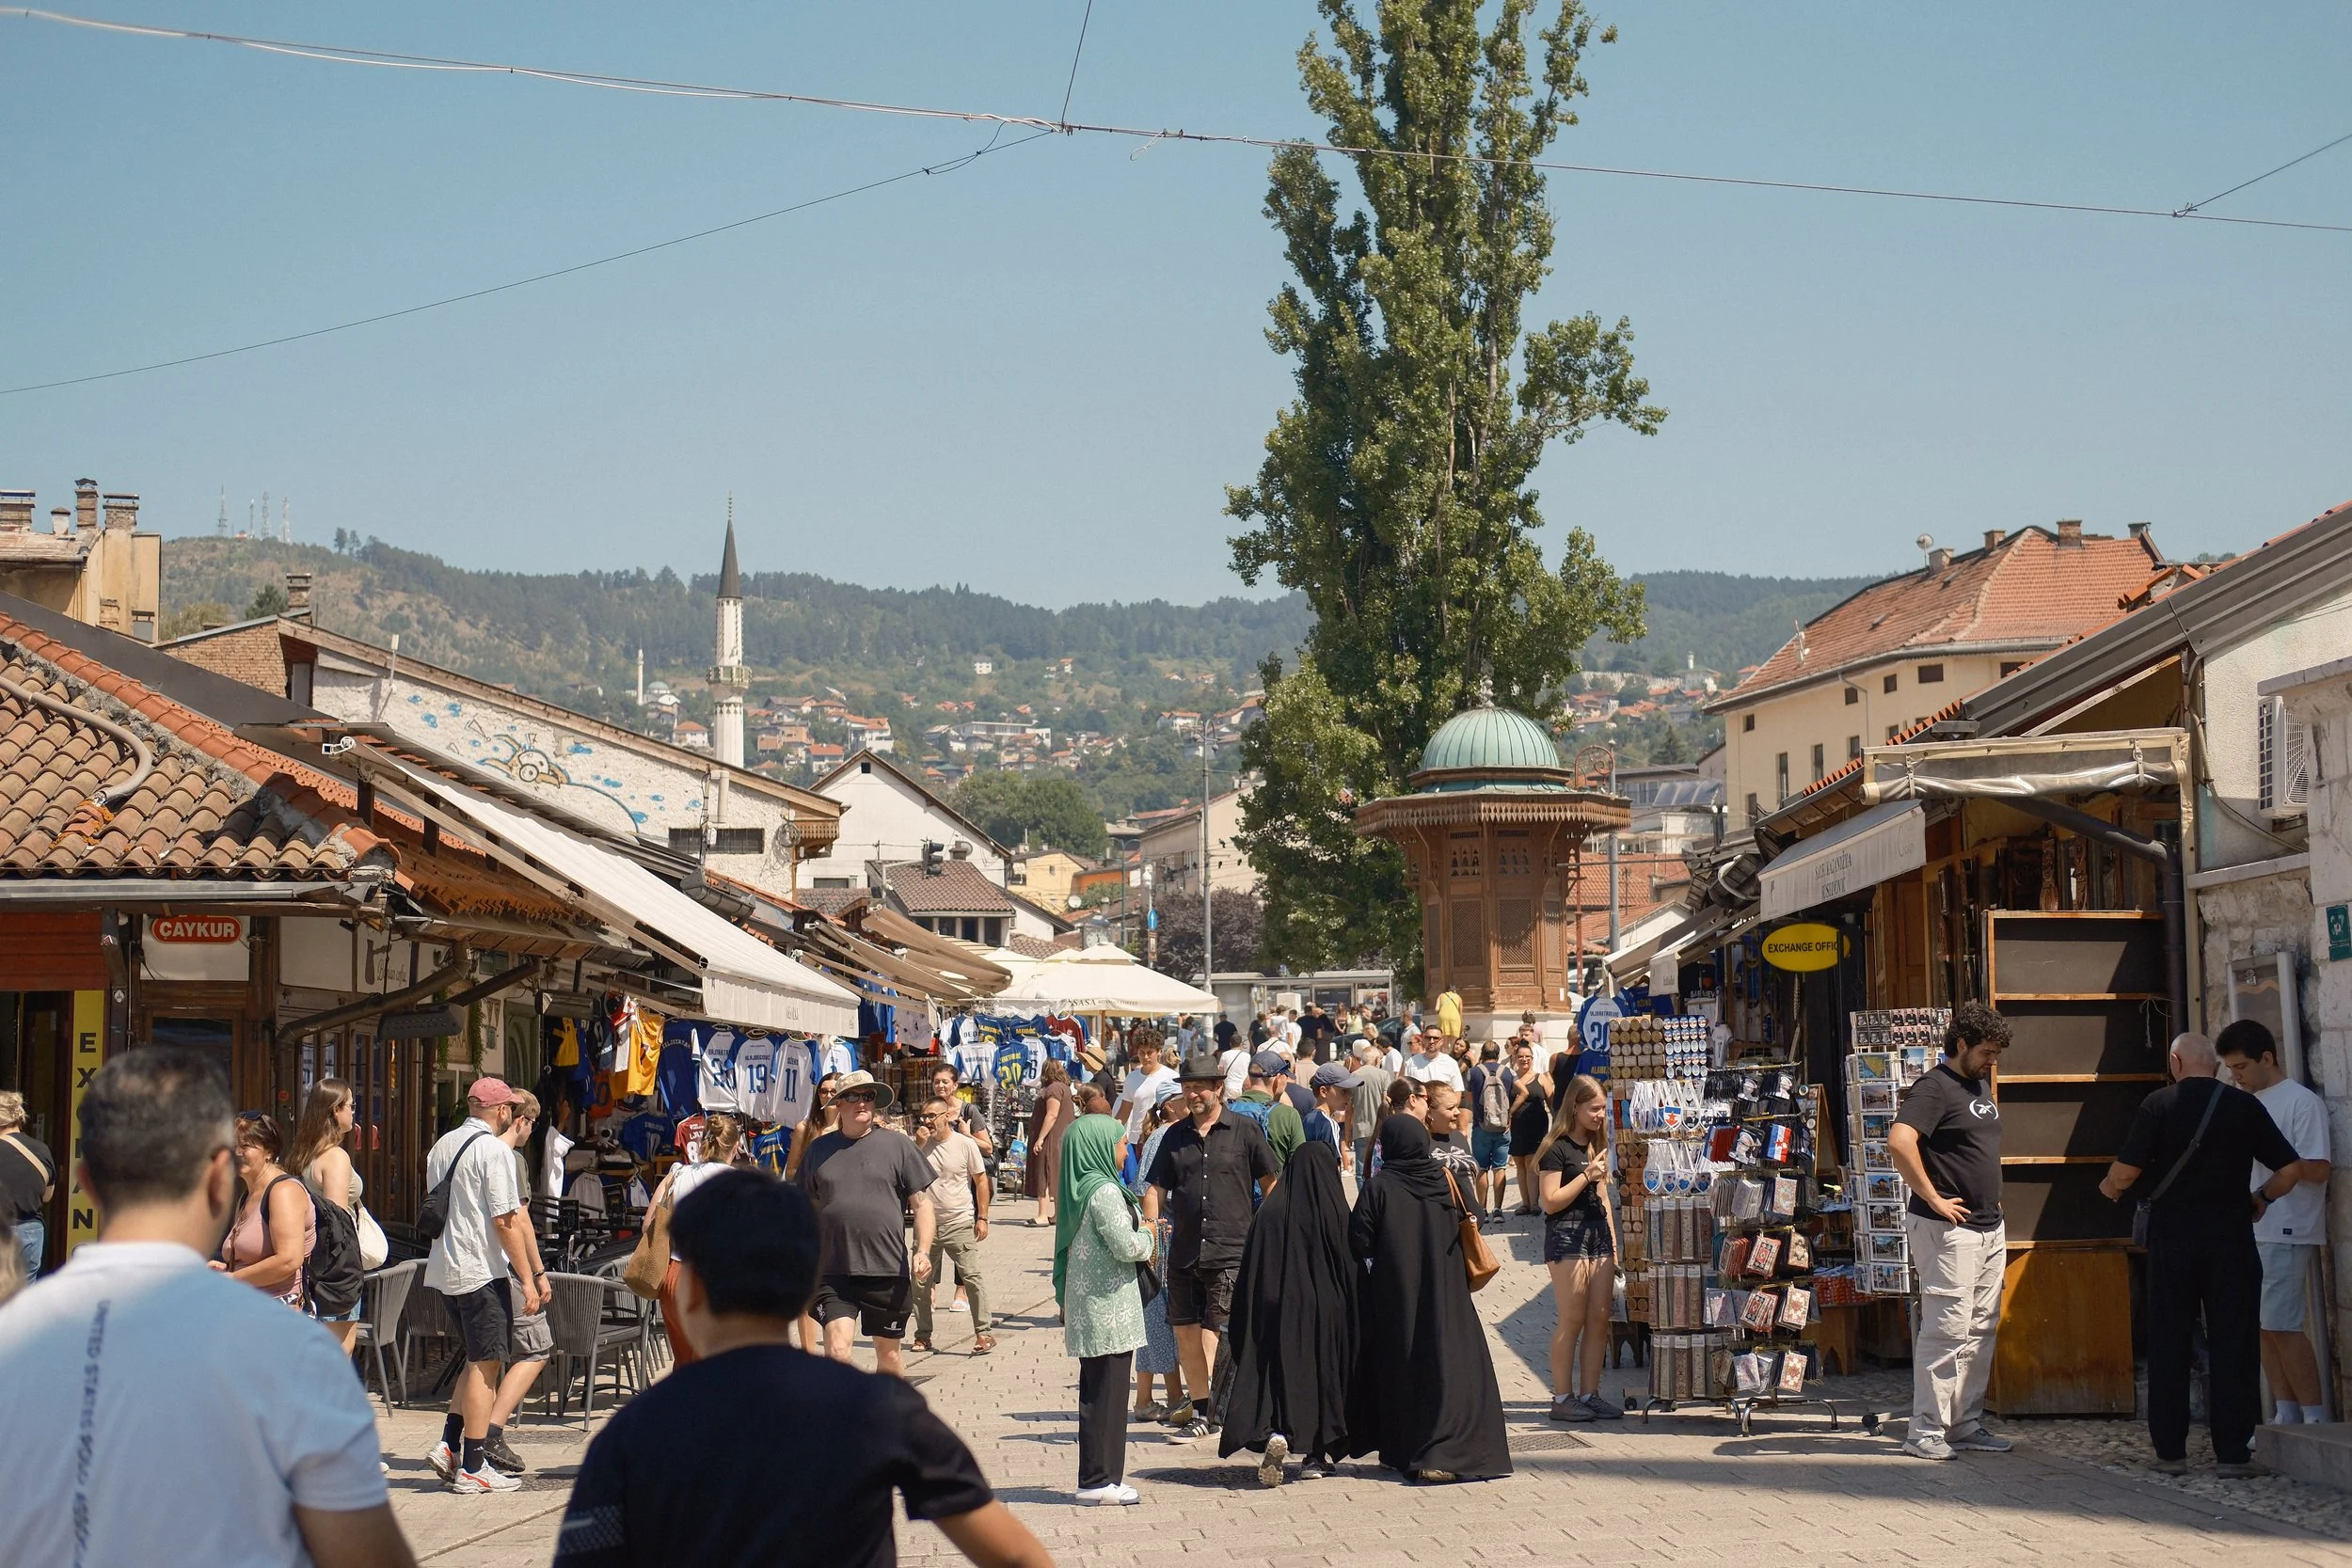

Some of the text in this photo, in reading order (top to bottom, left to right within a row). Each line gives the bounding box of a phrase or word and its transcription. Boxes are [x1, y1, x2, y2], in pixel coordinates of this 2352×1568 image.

[159, 921, 235, 940] ÇAYKUR
[1768, 942, 1838, 954] EXCHANGE OFFIC
[748, 1064, 768, 1094] 19
[784, 1068, 798, 1102] 11
